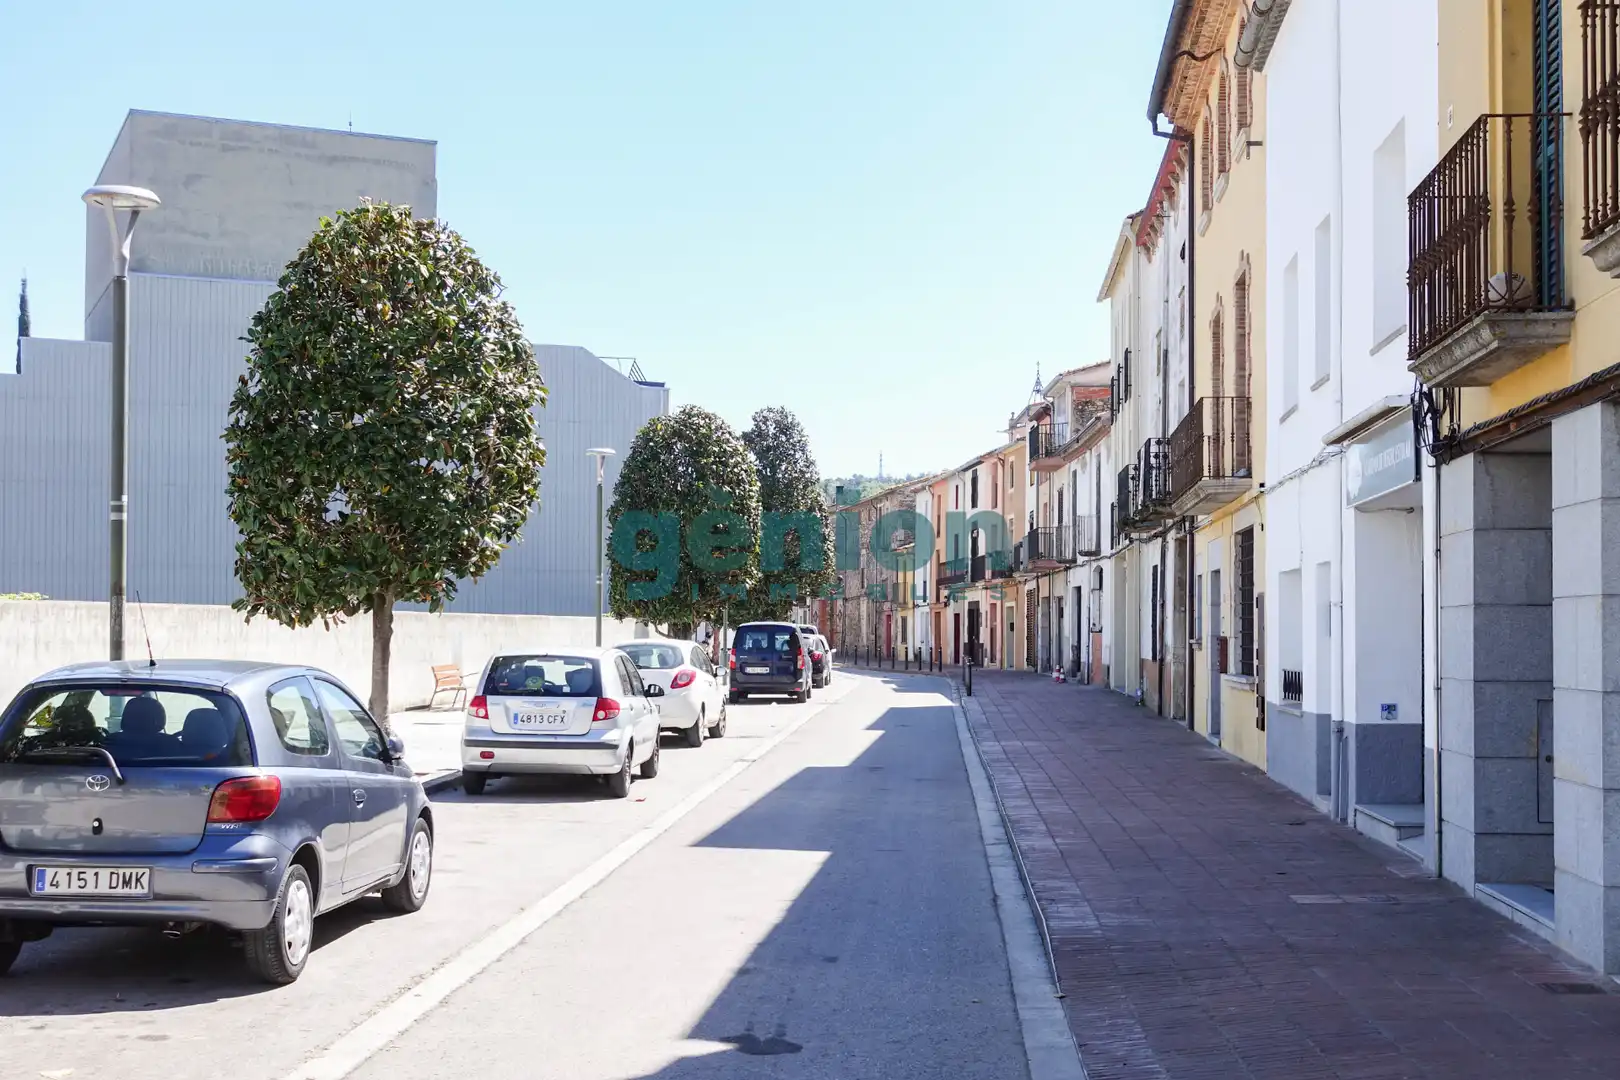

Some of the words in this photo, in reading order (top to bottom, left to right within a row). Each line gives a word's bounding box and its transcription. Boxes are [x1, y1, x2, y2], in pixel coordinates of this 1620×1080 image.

[519, 714, 544, 724] 4813
[547, 714, 565, 724] CFX
[49, 870, 99, 889] 4151
[108, 870, 146, 890] DMK
